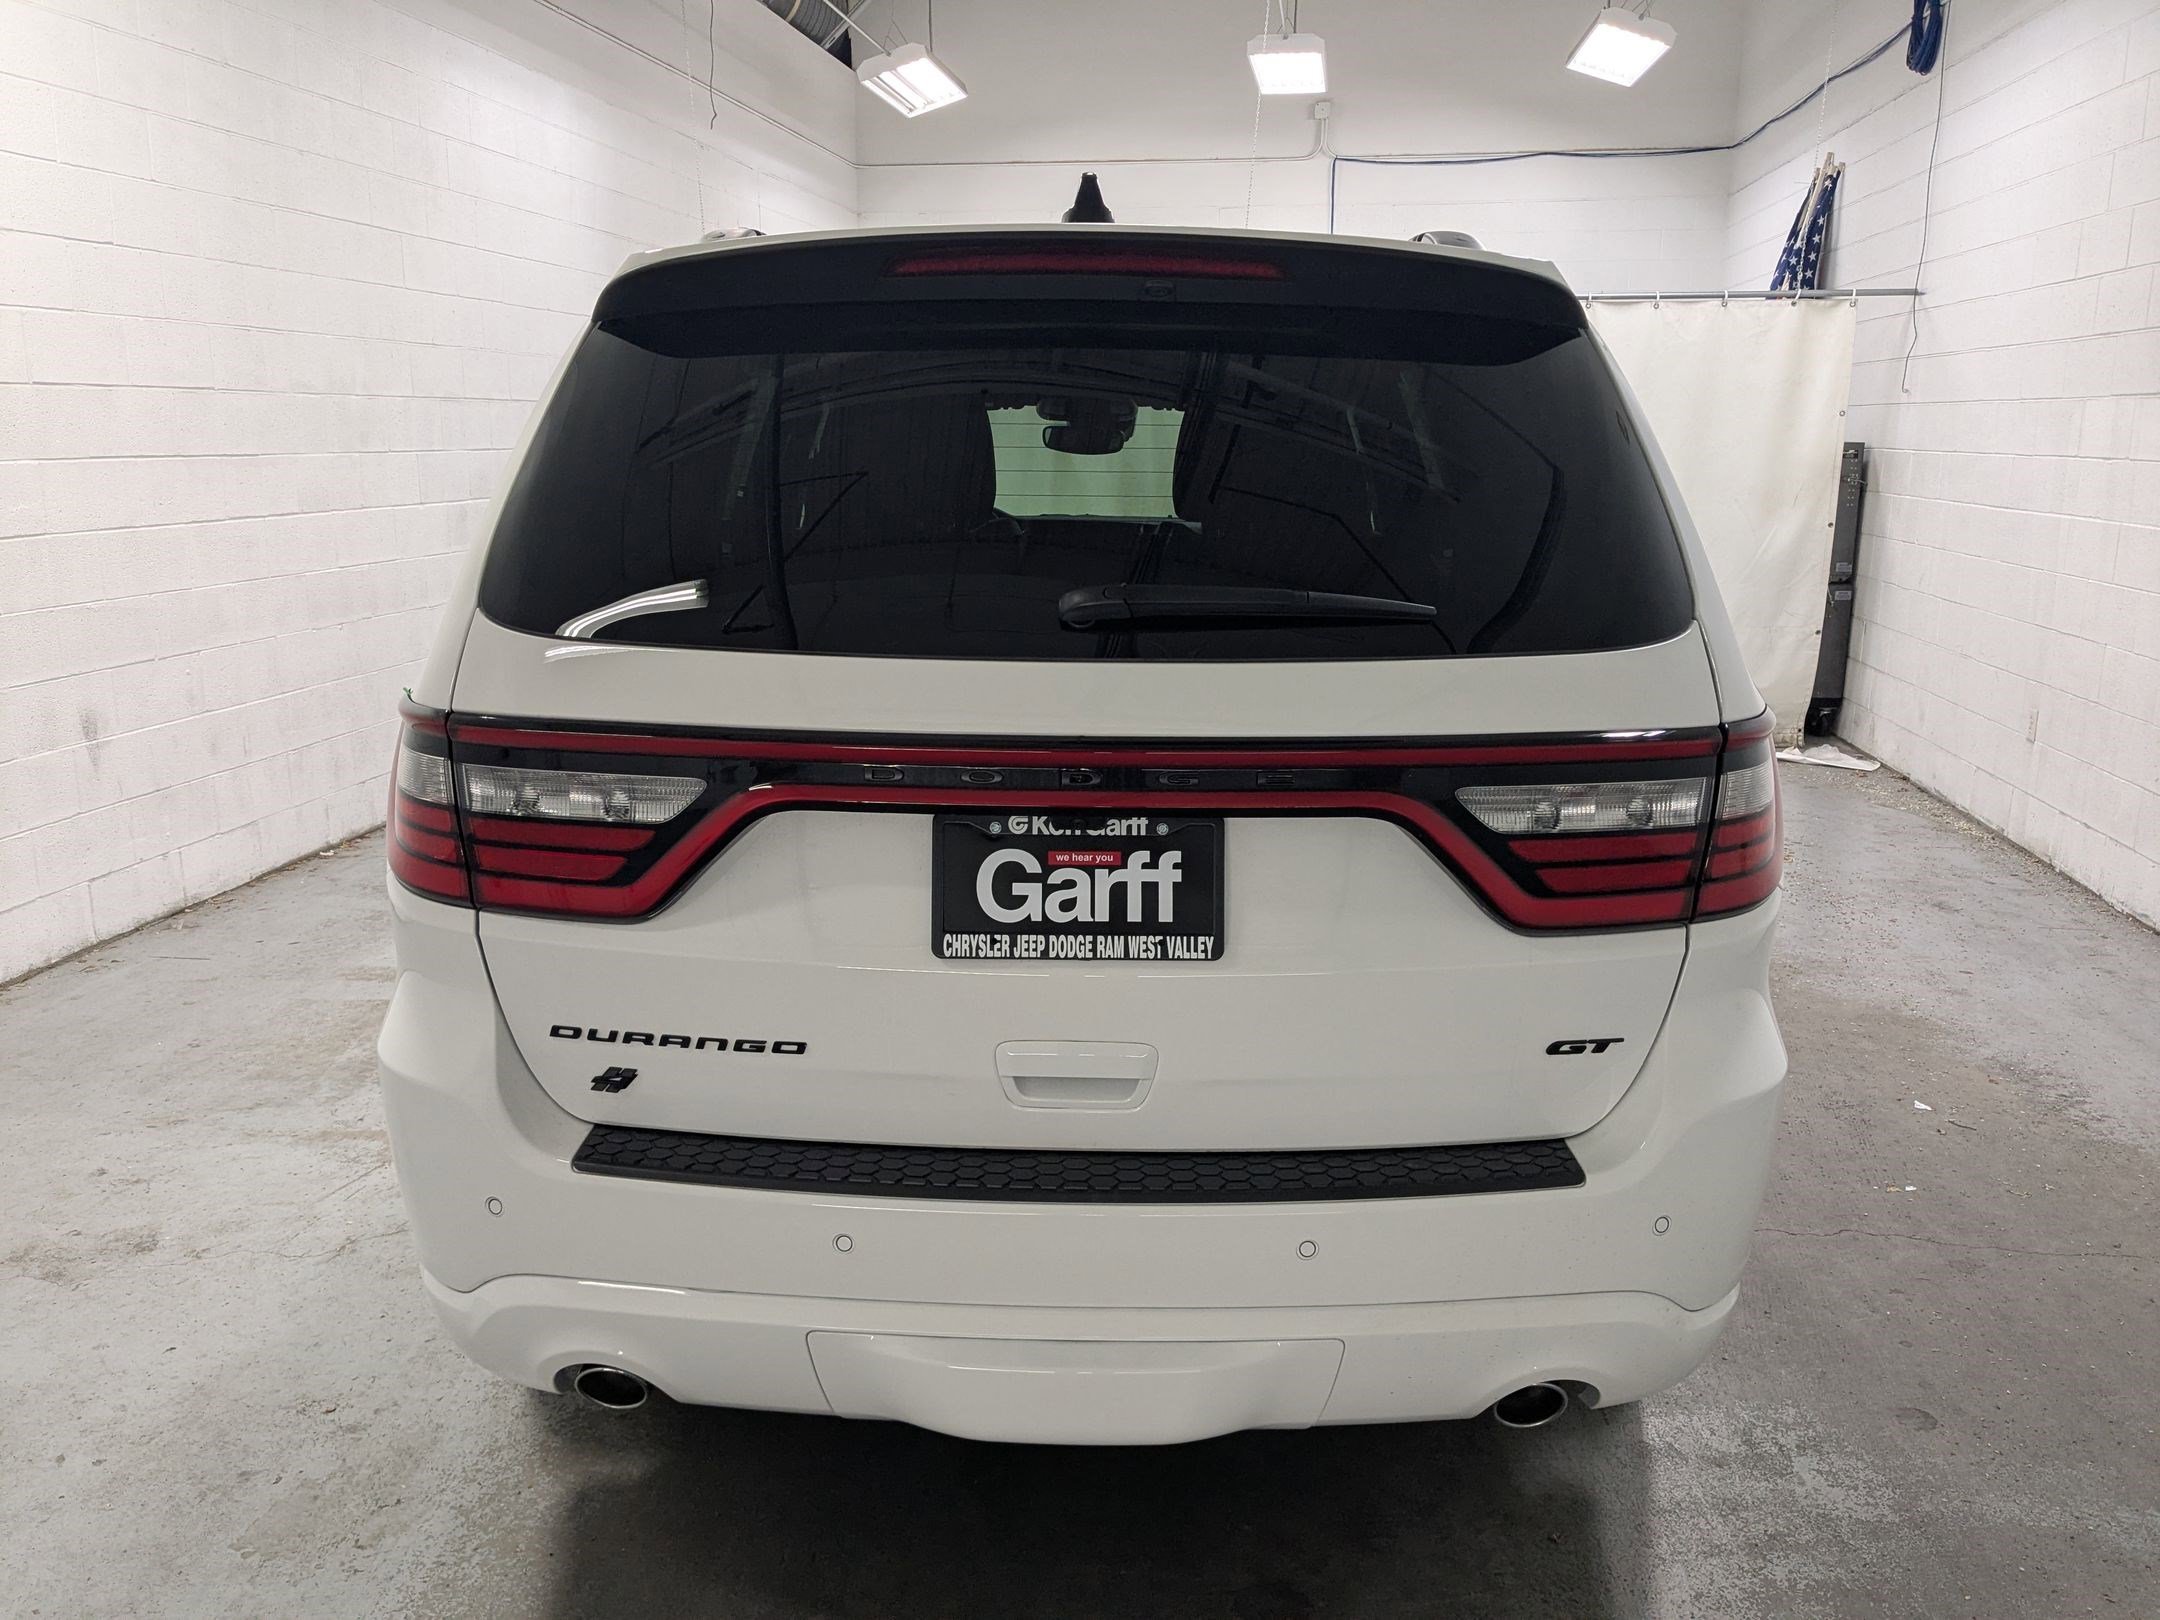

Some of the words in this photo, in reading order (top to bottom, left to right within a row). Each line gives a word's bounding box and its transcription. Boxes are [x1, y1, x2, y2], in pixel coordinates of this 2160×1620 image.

[1056, 854, 1069, 862] we
[1072, 853, 1092, 862] hear
[1094, 854, 1113, 863] you
[976, 849, 1182, 923] Garff
[943, 934, 1010, 958] CHRYSLER
[1013, 935, 1045, 958] JEEP
[1049, 935, 1093, 959] DODGE
[1097, 935, 1126, 959] RAM
[1128, 936, 1162, 959] WEST
[1166, 936, 1214, 959] VALLEY
[549, 1024, 807, 1054] DURANGO
[1546, 1038, 1624, 1055] GT
